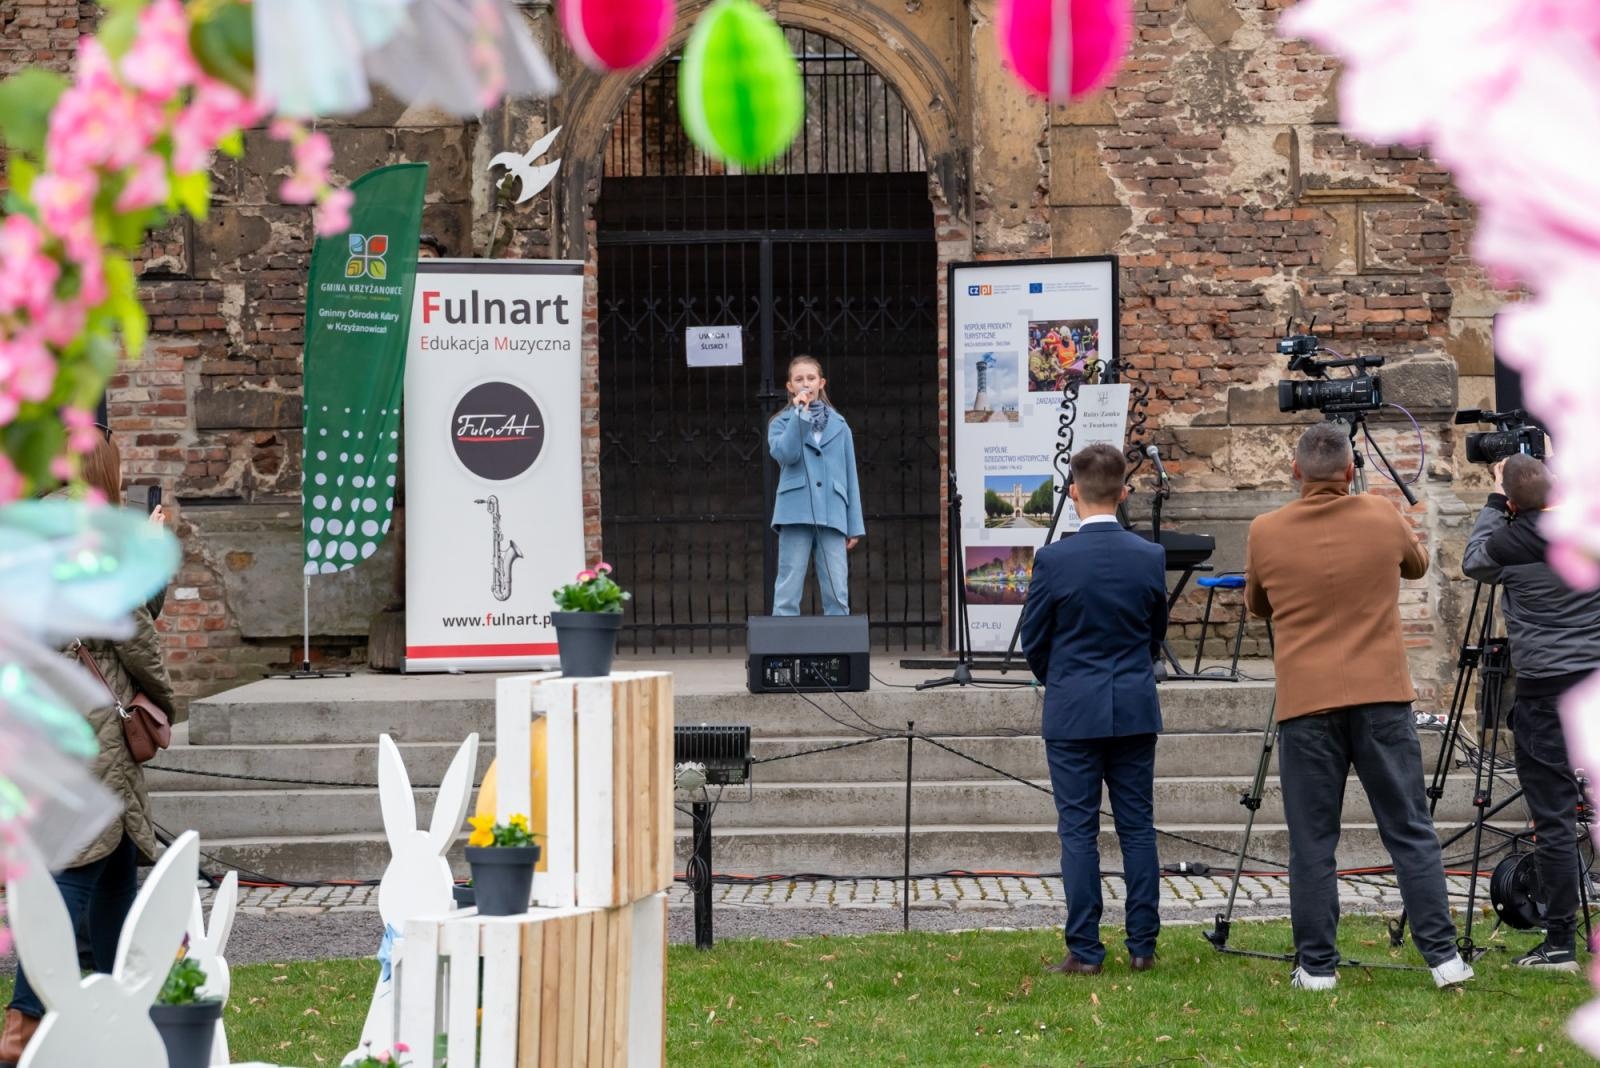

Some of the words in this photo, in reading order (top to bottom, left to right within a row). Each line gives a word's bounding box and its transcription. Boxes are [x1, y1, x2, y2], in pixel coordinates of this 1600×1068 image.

[320, 283, 346, 292] GMINA
[318, 308, 347, 319] Gminny
[348, 309, 379, 320] Ośrodek
[422, 289, 570, 325] Fulnart
[698, 332, 725, 340] UWGA
[420, 335, 489, 355] Edukacja
[494, 336, 571, 355] Muzyczna
[457, 413, 540, 438] FulnArt
[442, 613, 552, 629] www.fulnart.p
